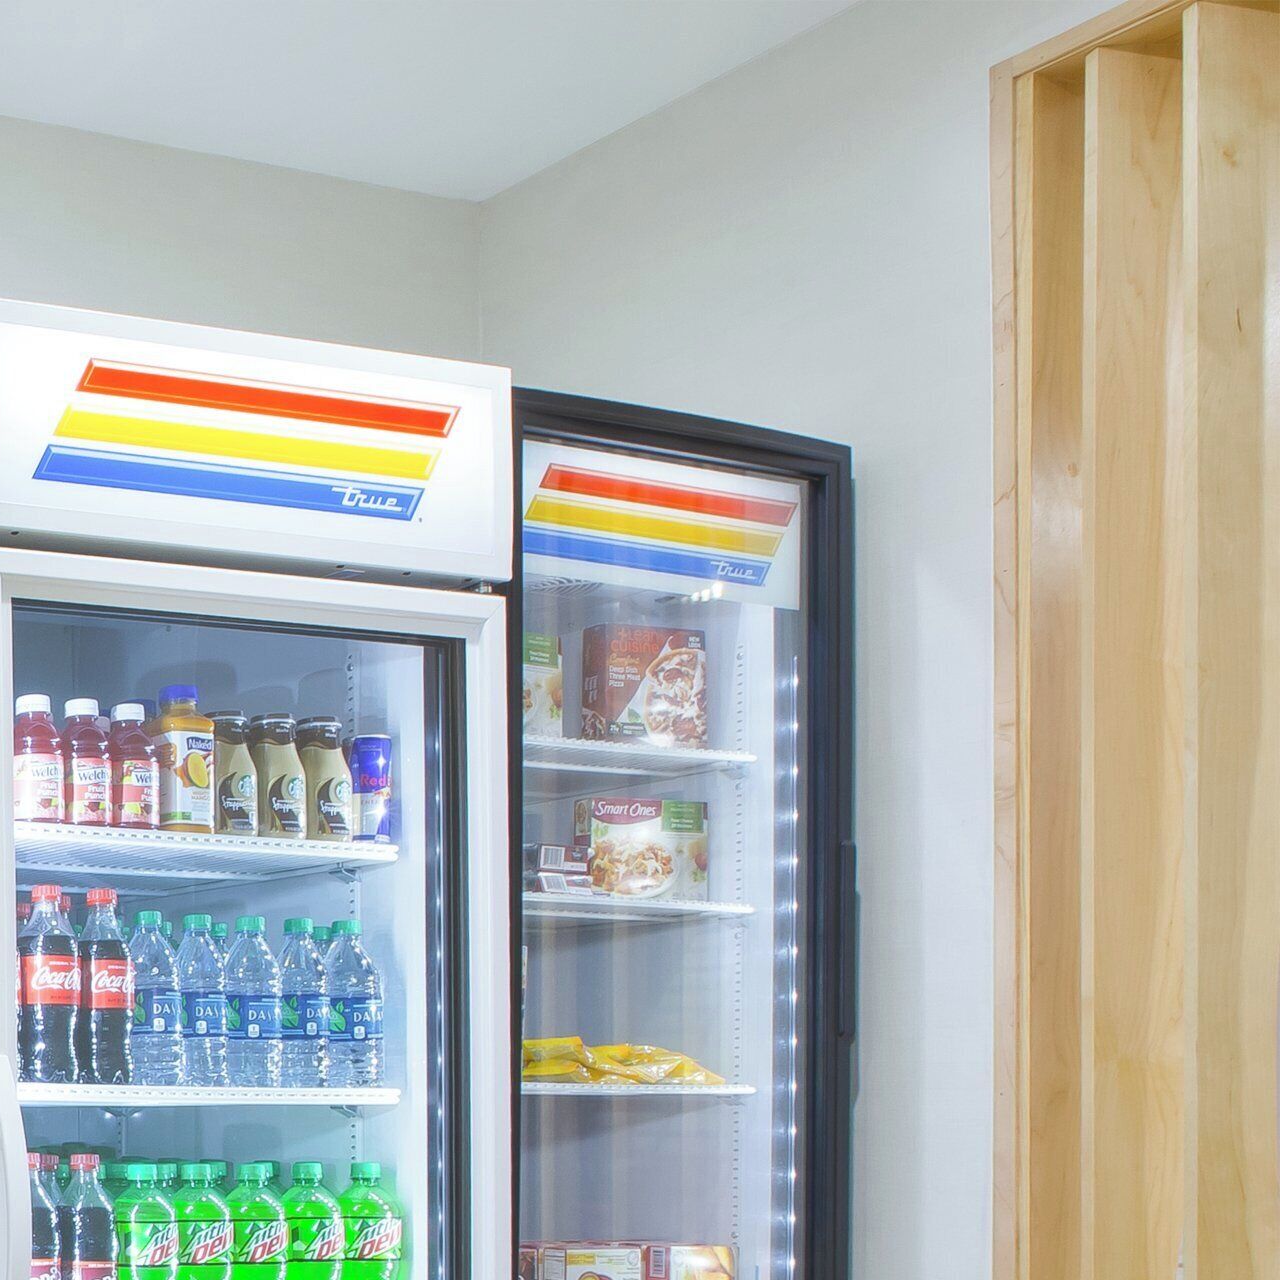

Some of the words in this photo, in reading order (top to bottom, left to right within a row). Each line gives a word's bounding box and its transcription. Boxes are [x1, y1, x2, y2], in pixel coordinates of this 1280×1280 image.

[360, 775, 386, 787] Red
[595, 801, 629, 816] Smart
[630, 803, 657, 816] Ones
